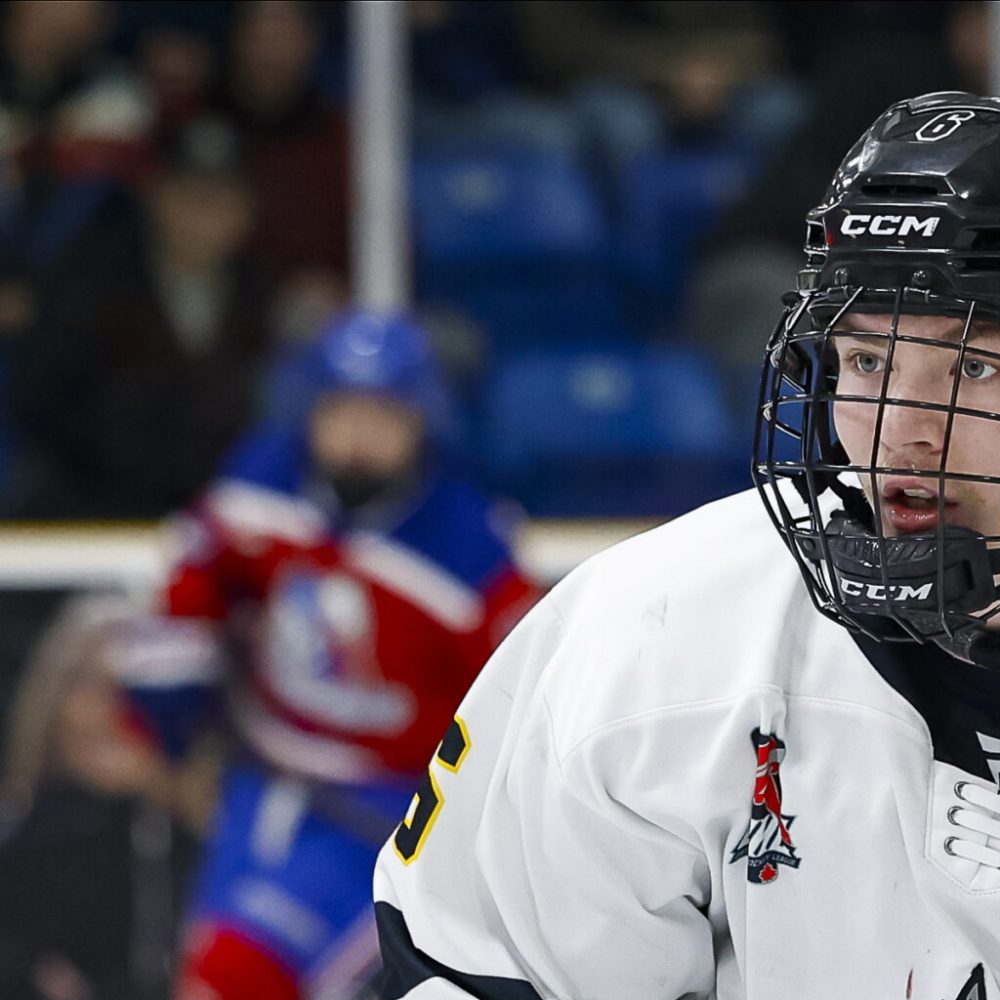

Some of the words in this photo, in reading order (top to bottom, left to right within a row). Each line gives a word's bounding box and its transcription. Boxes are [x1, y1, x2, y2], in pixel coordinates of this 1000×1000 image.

[915, 110, 976, 141] 6
[840, 214, 941, 237] CCM
[840, 576, 933, 601] CCM
